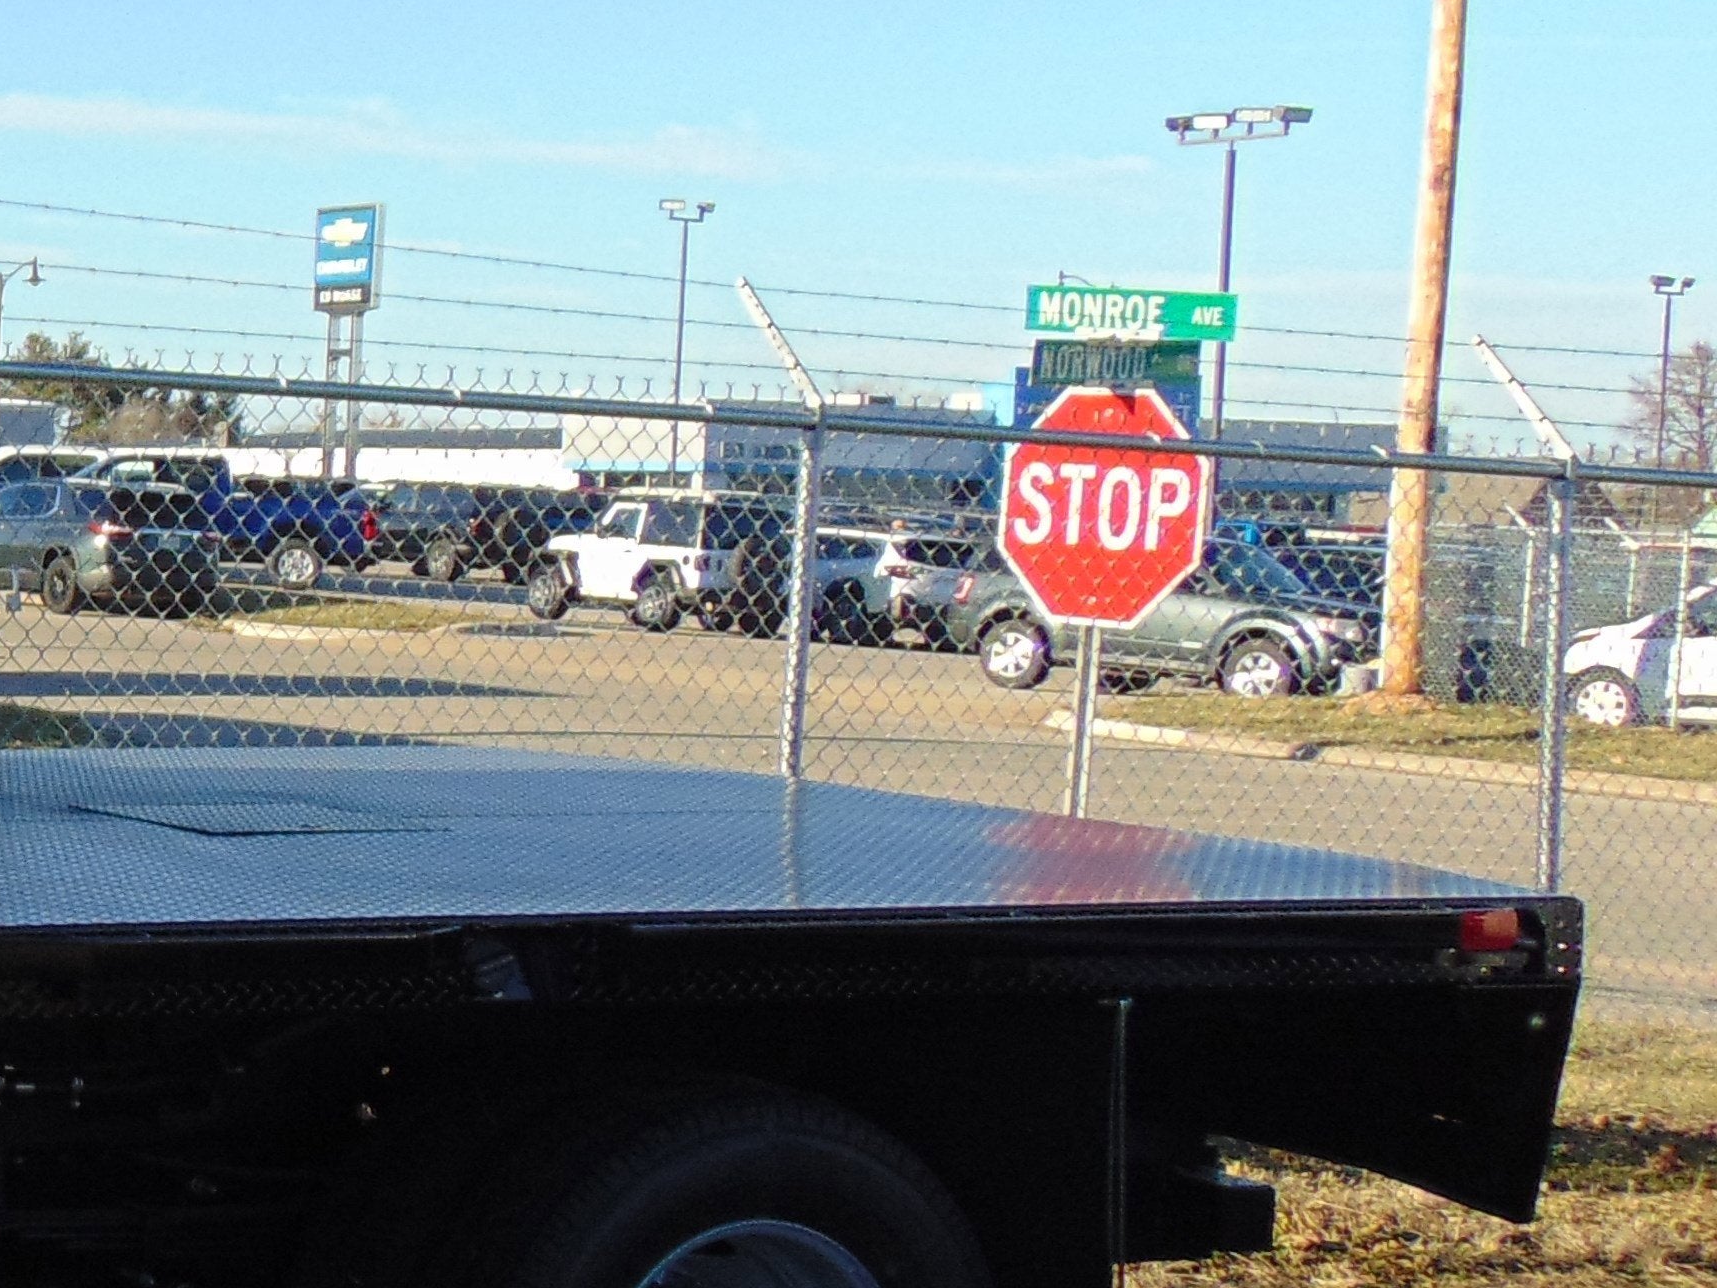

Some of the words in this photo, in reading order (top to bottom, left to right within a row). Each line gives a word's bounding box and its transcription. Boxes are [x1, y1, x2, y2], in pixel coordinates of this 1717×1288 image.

[1038, 290, 1166, 332] MONROE
[1191, 306, 1224, 326] AVE
[1040, 343, 1148, 380] NORWOOD
[1013, 461, 1192, 551] STOP
